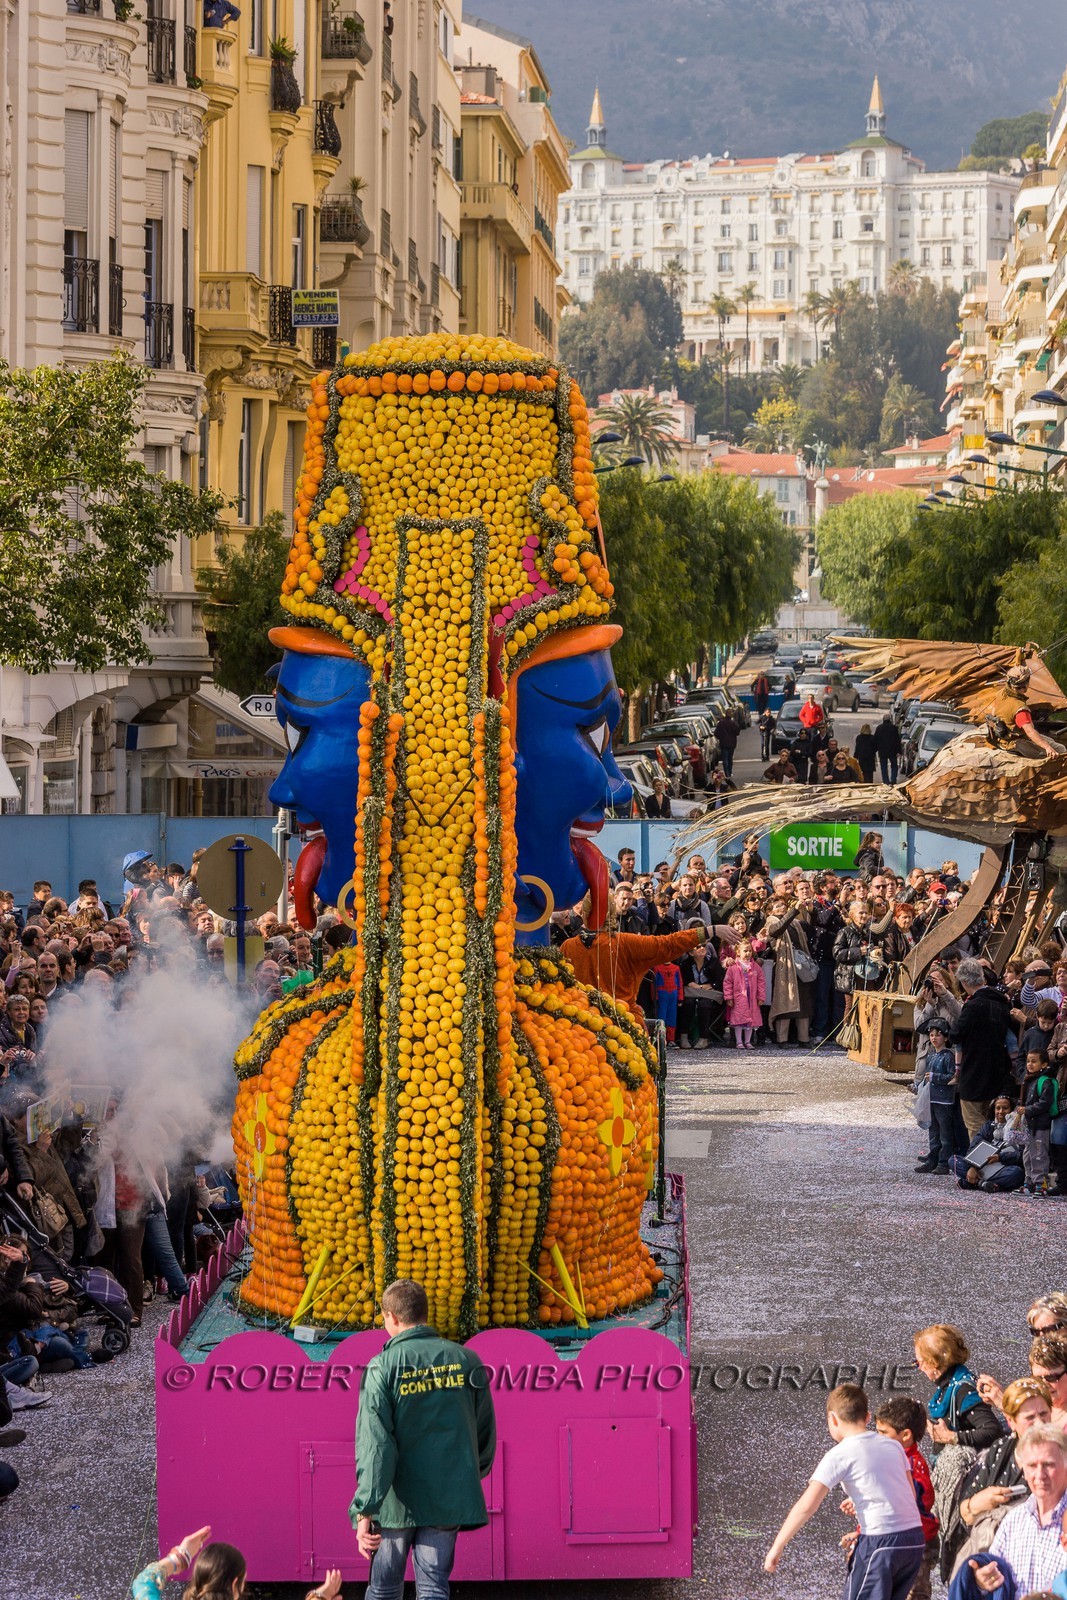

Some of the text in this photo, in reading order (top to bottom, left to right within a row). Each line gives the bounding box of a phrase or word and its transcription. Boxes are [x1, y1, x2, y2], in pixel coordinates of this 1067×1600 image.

[294, 304, 315, 313] AGENCE
[787, 836, 843, 857] SORTIE
[400, 1374, 465, 1396] CONTRÔLE
